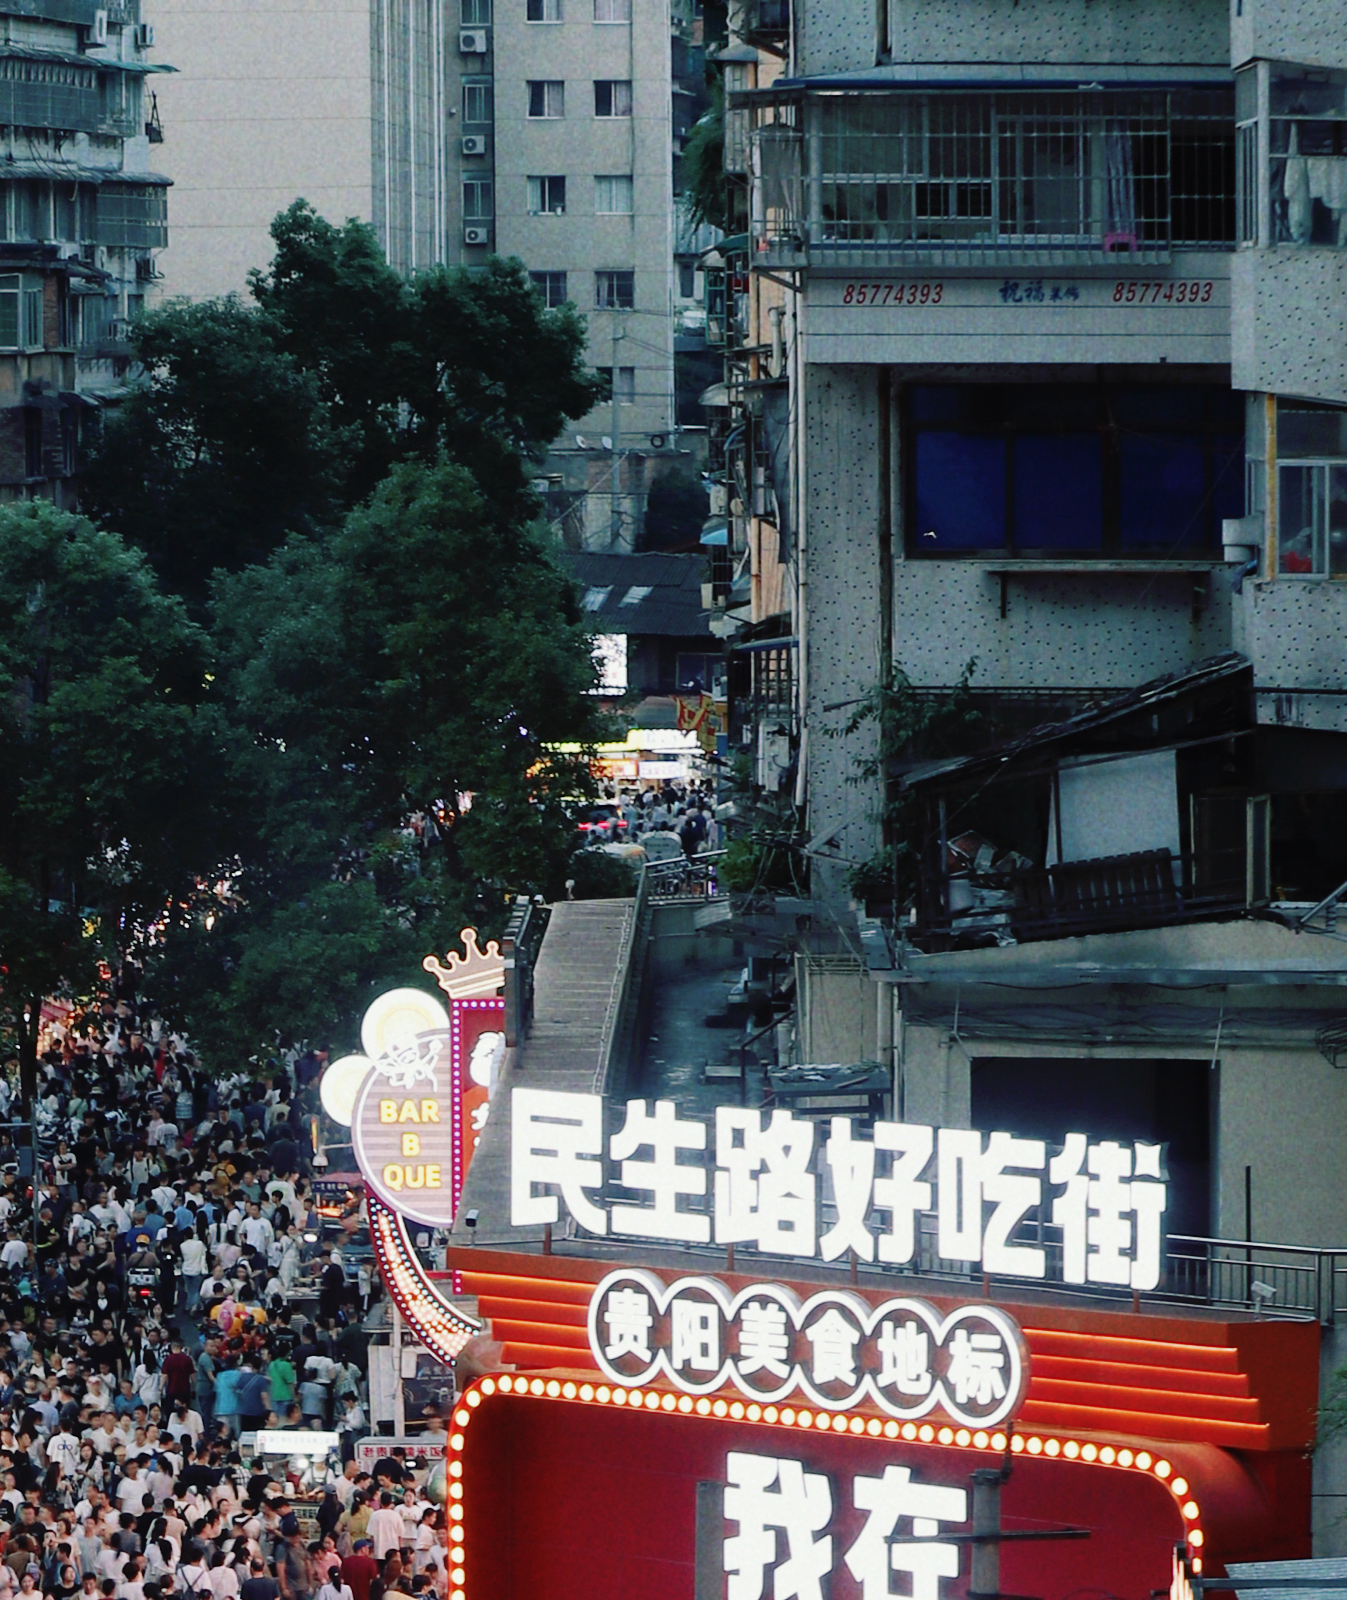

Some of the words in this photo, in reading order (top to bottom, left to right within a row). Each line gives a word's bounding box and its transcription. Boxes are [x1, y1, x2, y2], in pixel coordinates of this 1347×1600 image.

[843, 283, 943, 305] 85774393
[1113, 281, 1213, 303] 85774393
[379, 1099, 440, 1123] BAR
[402, 1132, 420, 1157] B
[383, 1163, 442, 1191] QUE
[511, 1087, 1167, 1291] 民生路好吃街
[603, 1287, 1007, 1404] 贵阳美食地标
